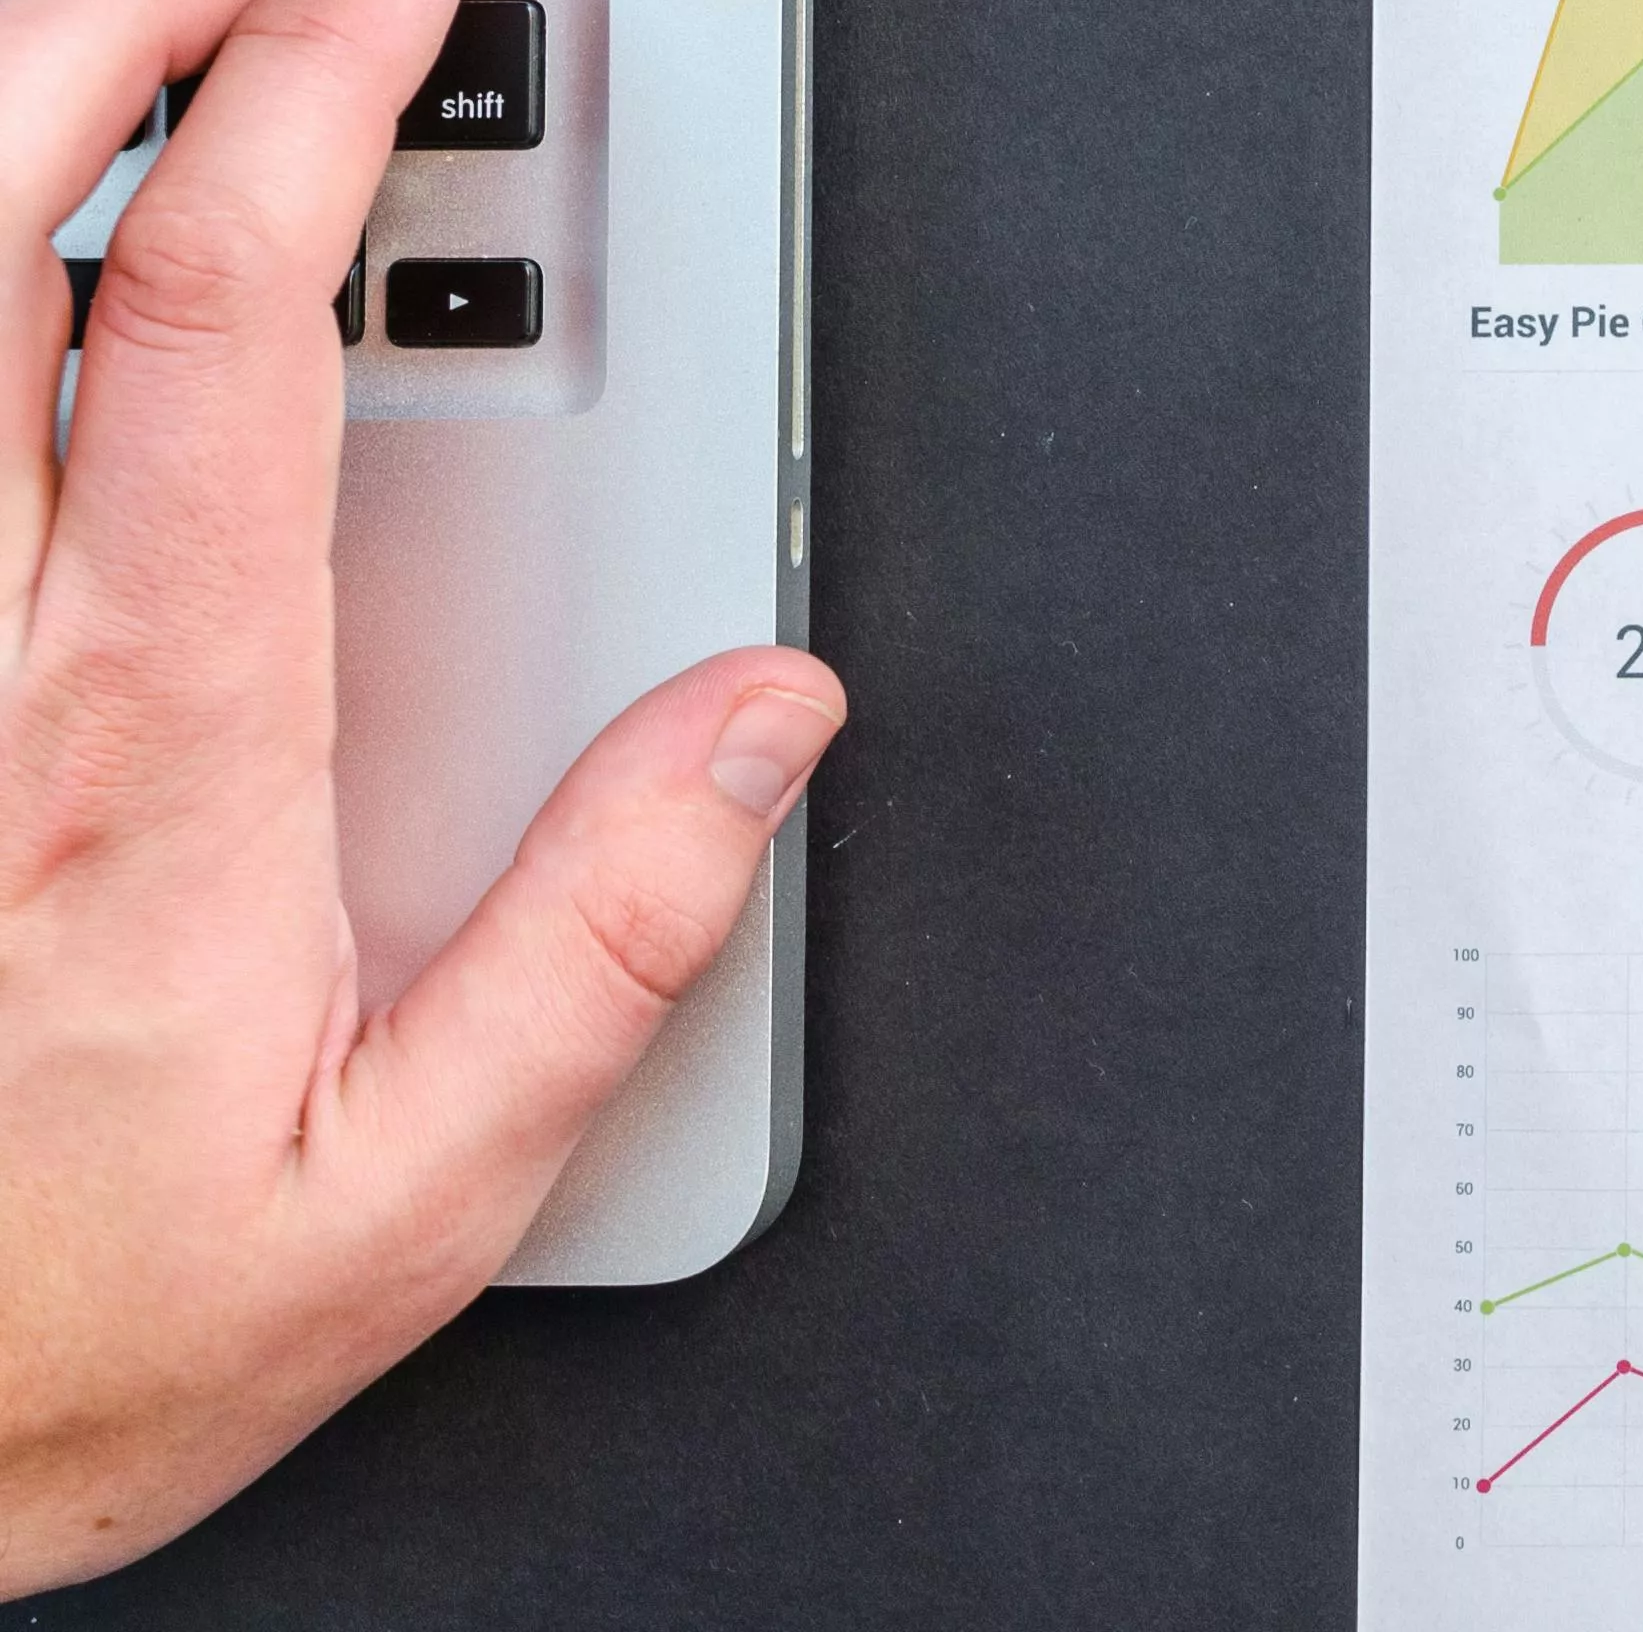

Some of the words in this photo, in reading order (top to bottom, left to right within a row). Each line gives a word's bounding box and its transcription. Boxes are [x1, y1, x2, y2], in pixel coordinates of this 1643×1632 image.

[441, 90, 505, 119] shift
[1471, 306, 1559, 347] Easy
[1571, 304, 1630, 338] Pie
[1453, 948, 1480, 962] 100
[1457, 1006, 1475, 1020] 90
[1456, 1064, 1474, 1079] 80
[1455, 1122, 1474, 1137] 70
[1455, 1182, 1474, 1196] 60
[1455, 1240, 1473, 1254] 50
[1454, 1299, 1472, 1313] 40
[1453, 1358, 1472, 1372] 30
[1453, 1417, 1471, 1431] 20
[1453, 1476, 1470, 1490] 10
[1455, 1535, 1465, 1550] 0
